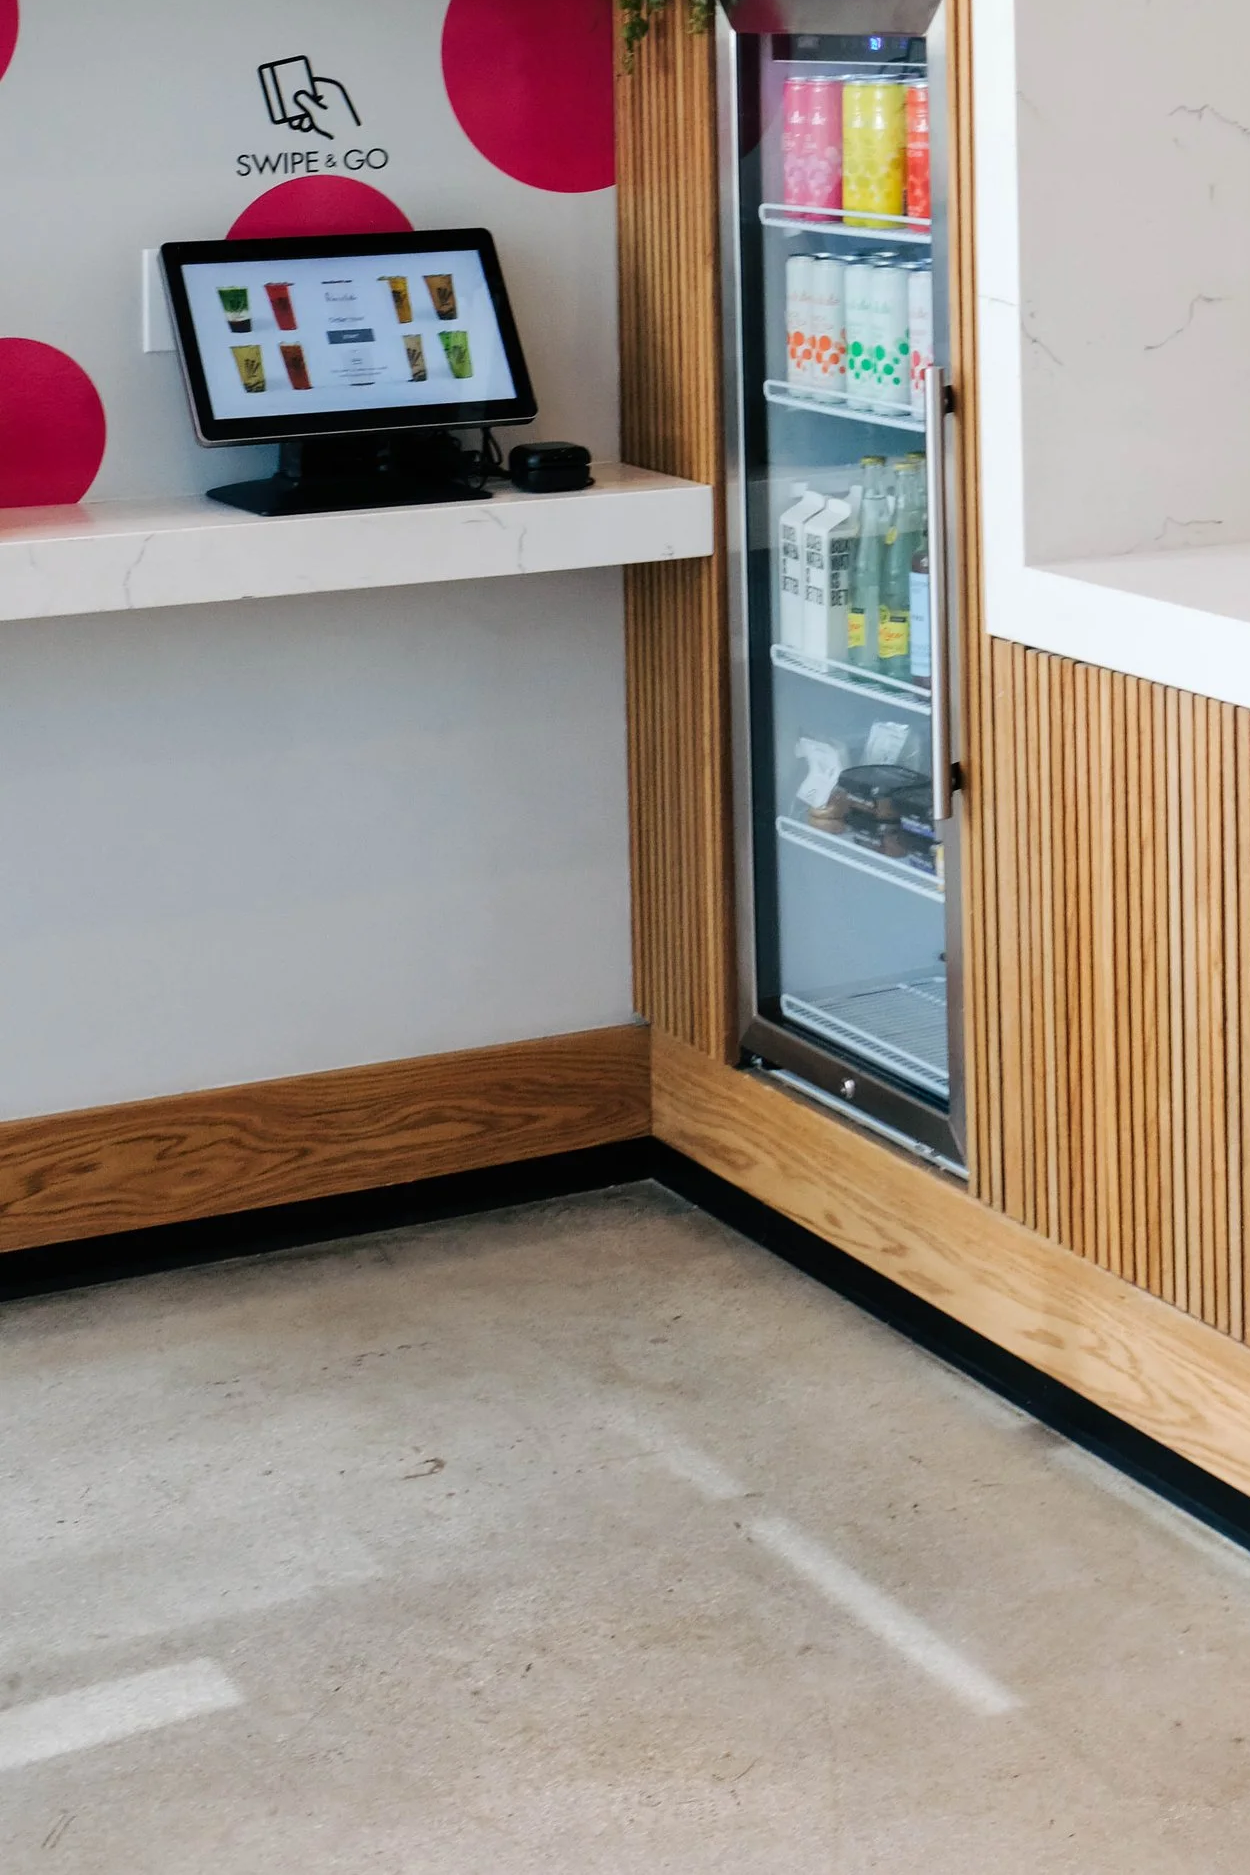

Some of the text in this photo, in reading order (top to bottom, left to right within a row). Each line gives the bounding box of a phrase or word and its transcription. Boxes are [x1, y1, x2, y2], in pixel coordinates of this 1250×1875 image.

[236, 148, 389, 176] SWIPE & GO
